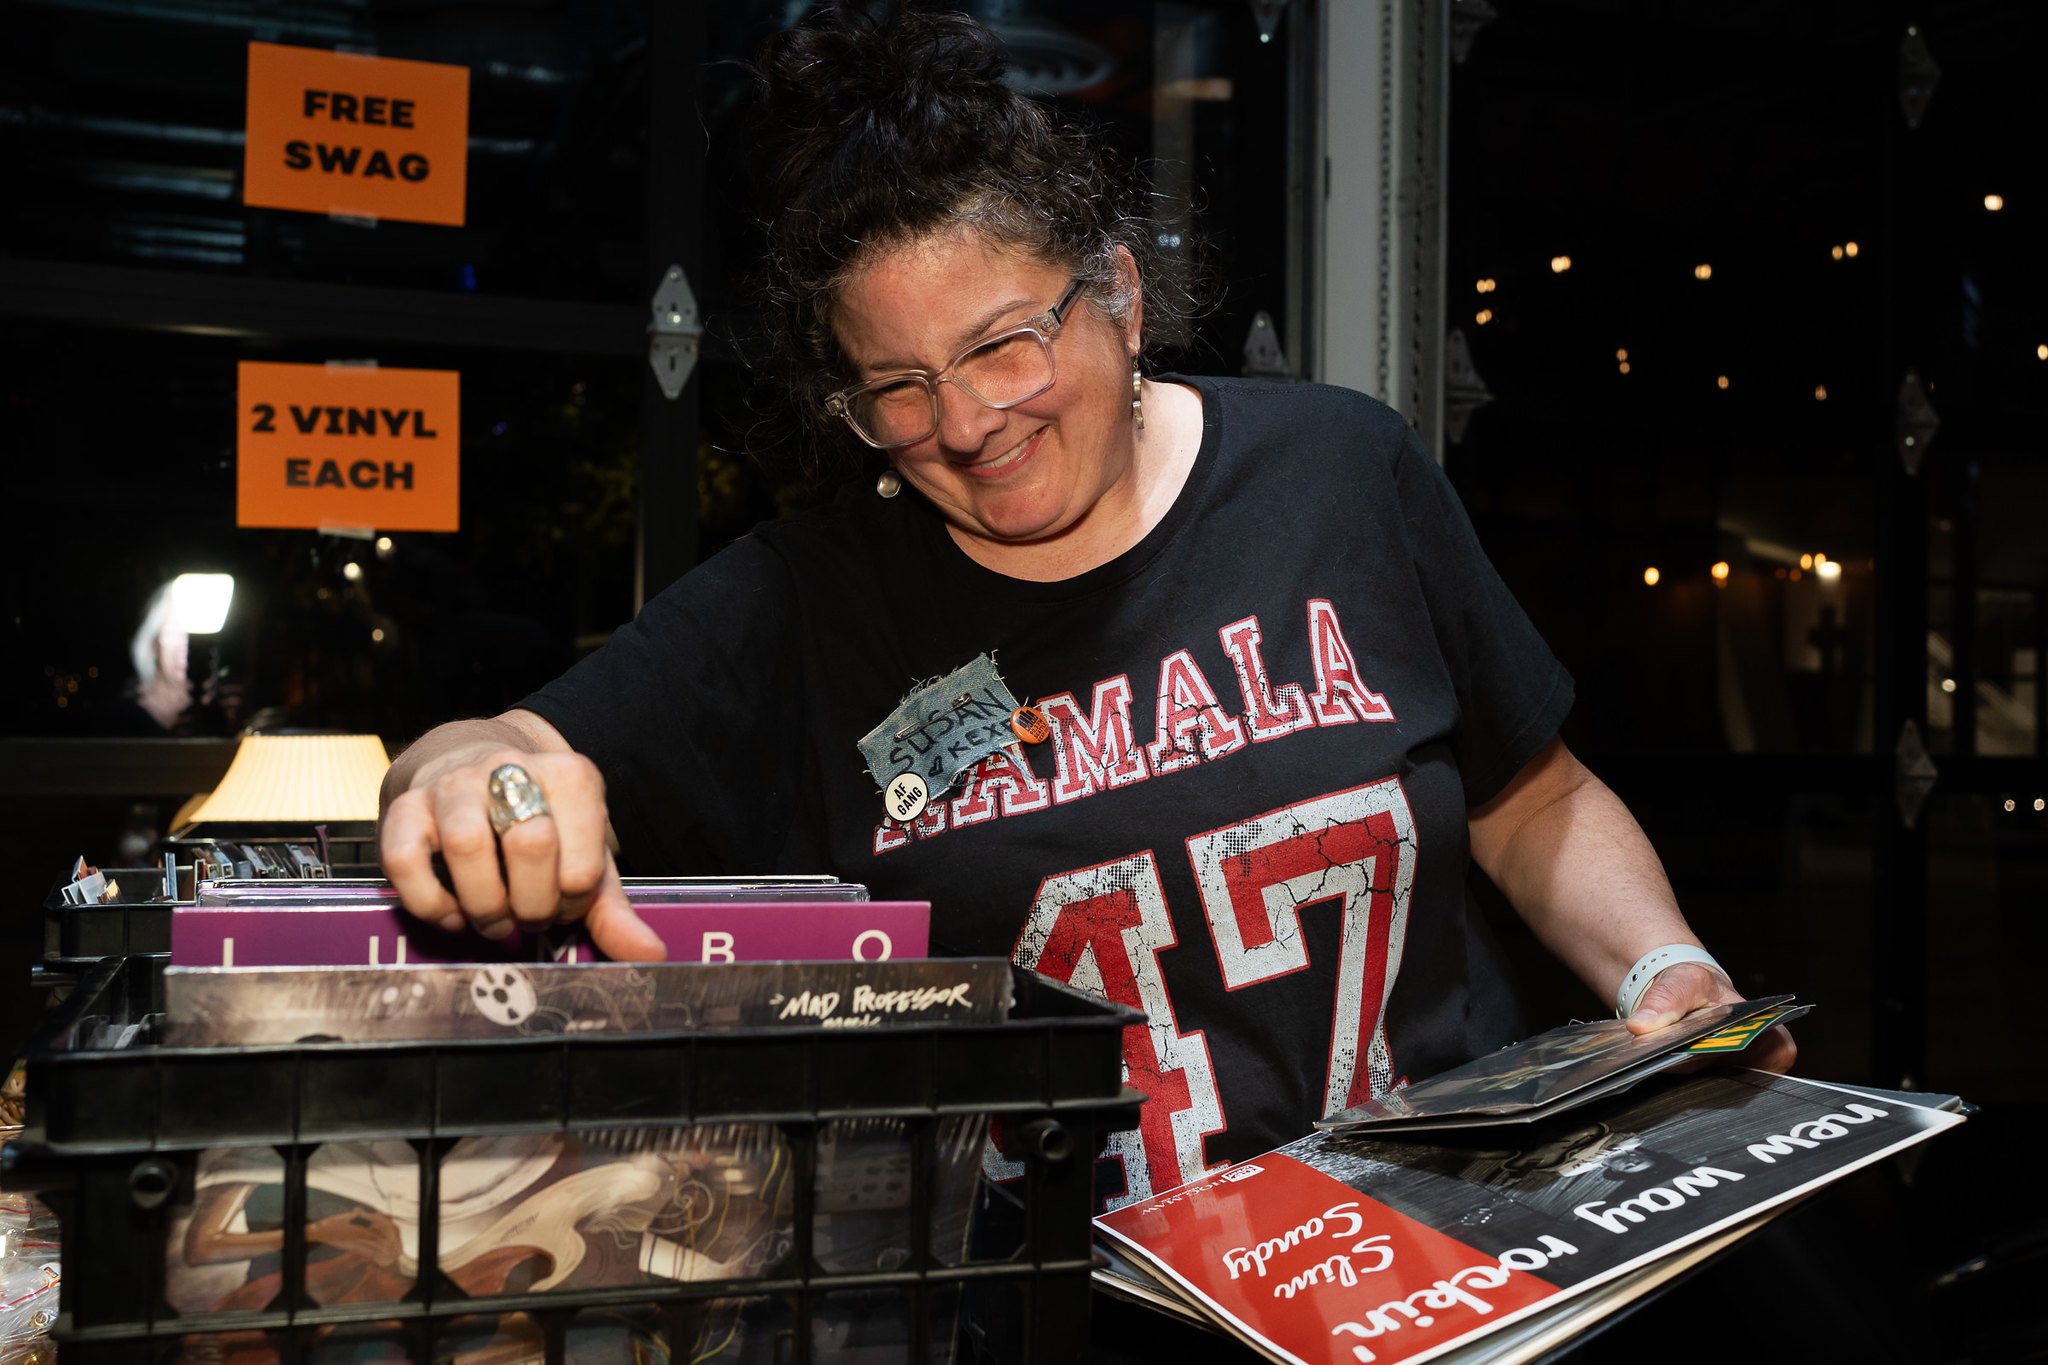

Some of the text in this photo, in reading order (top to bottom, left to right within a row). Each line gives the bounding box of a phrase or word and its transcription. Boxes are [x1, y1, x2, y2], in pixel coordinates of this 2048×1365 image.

[303, 88, 415, 129] FREE
[284, 139, 431, 183] SWAG
[251, 403, 438, 438] 2 VINYL
[286, 458, 415, 491] EACH
[873, 598, 1399, 856] AMALA
[889, 687, 1012, 773] SUSAN
[894, 782, 906, 800] AF
[897, 786, 923, 816] GANG
[779, 989, 840, 1020] MAD
[1746, 1103, 1889, 1164] new
[1573, 1166, 1746, 1234] way
[1221, 1202, 1363, 1280] Sandy
[1273, 1234, 1394, 1299] Slim
